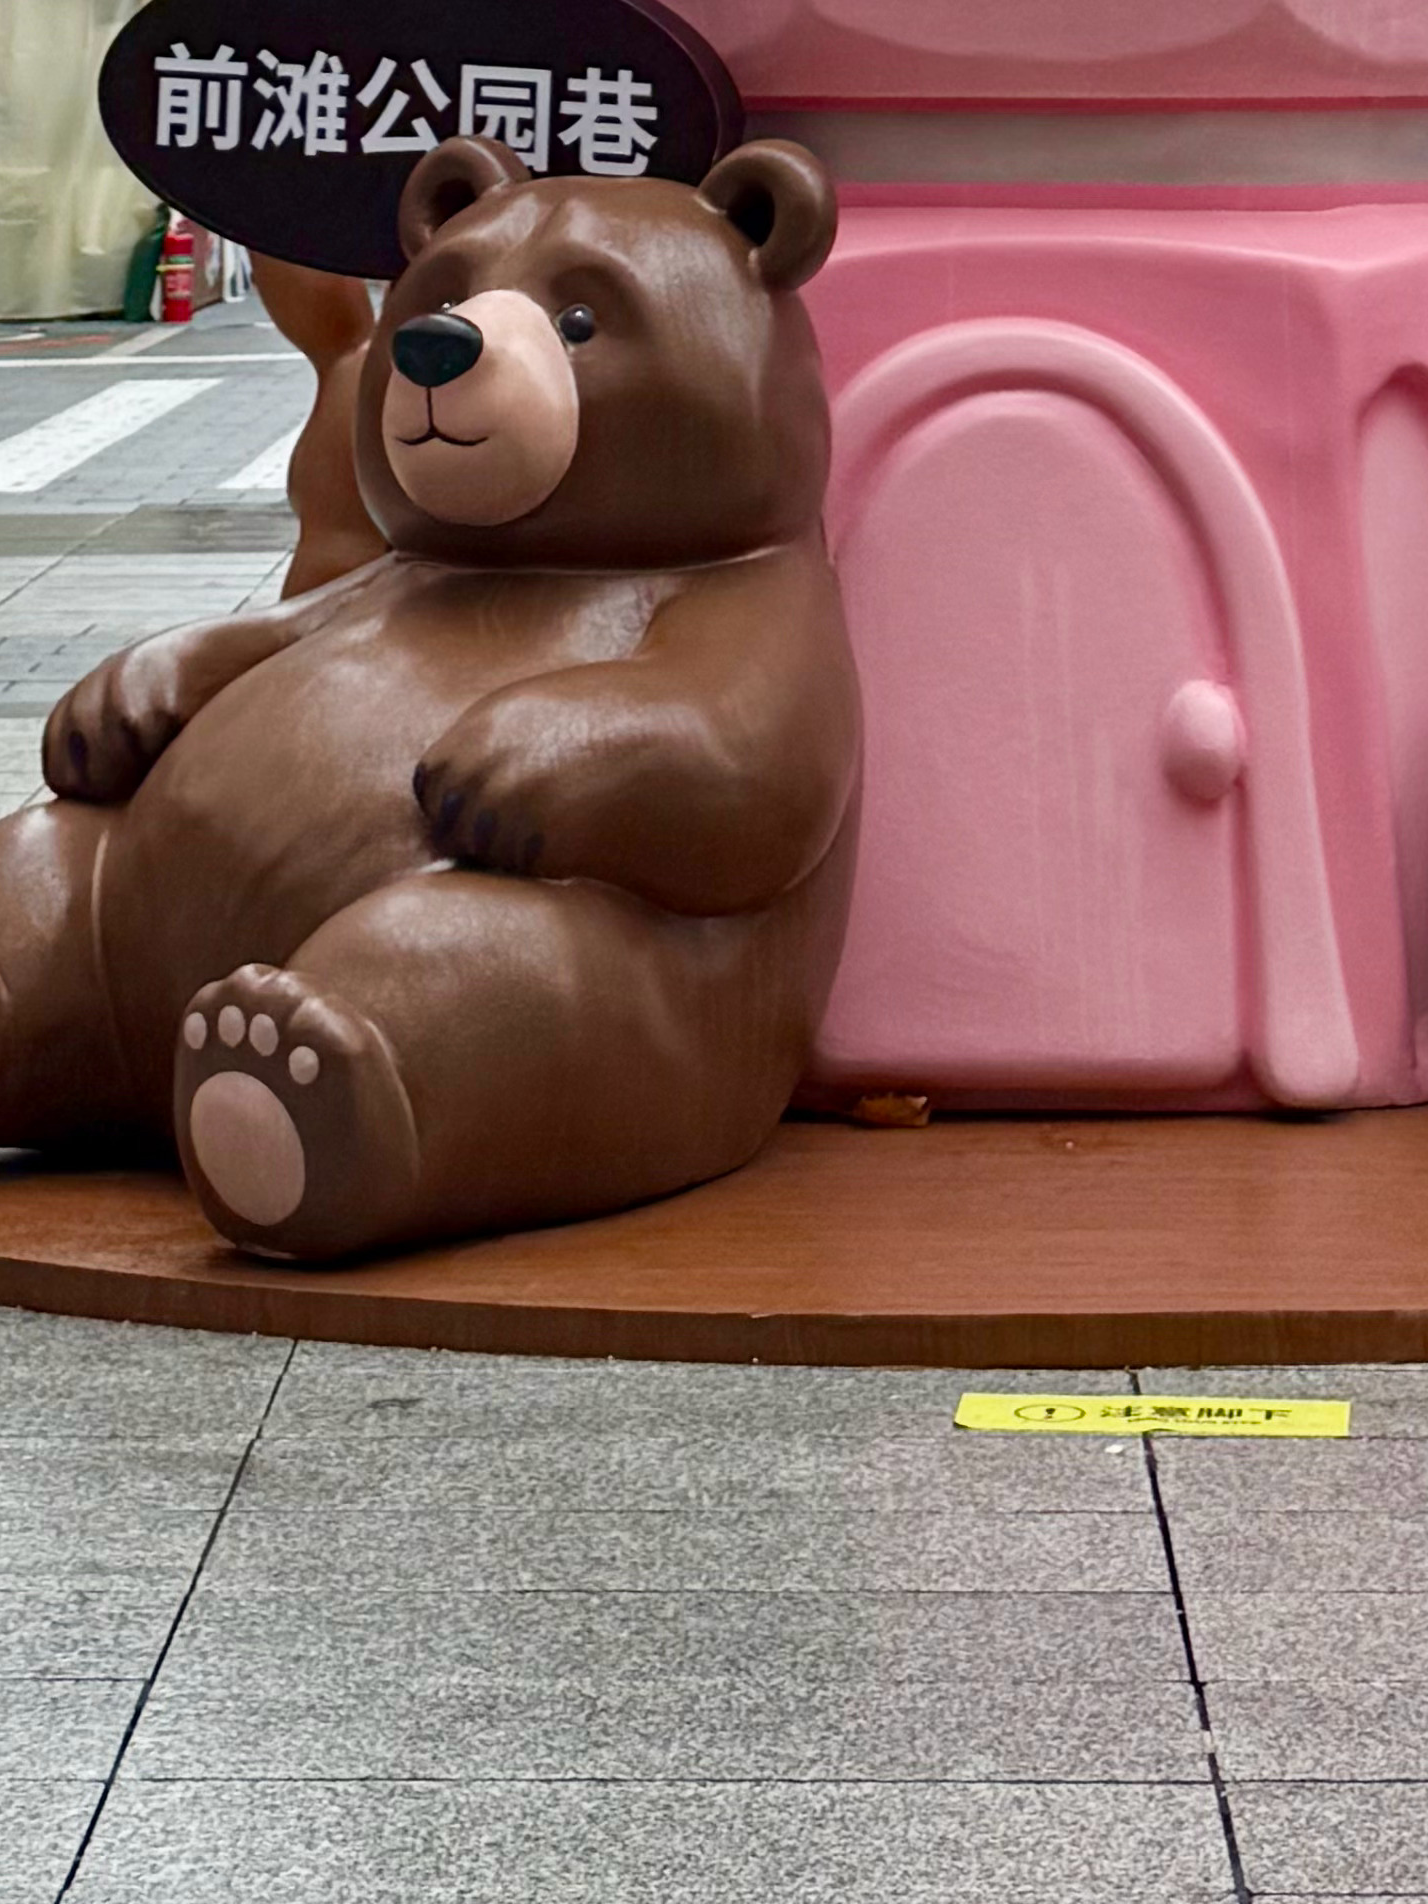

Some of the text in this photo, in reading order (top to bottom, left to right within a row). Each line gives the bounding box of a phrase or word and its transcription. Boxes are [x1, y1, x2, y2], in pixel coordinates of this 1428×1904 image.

[154, 43, 658, 176] 前滩公园巷
